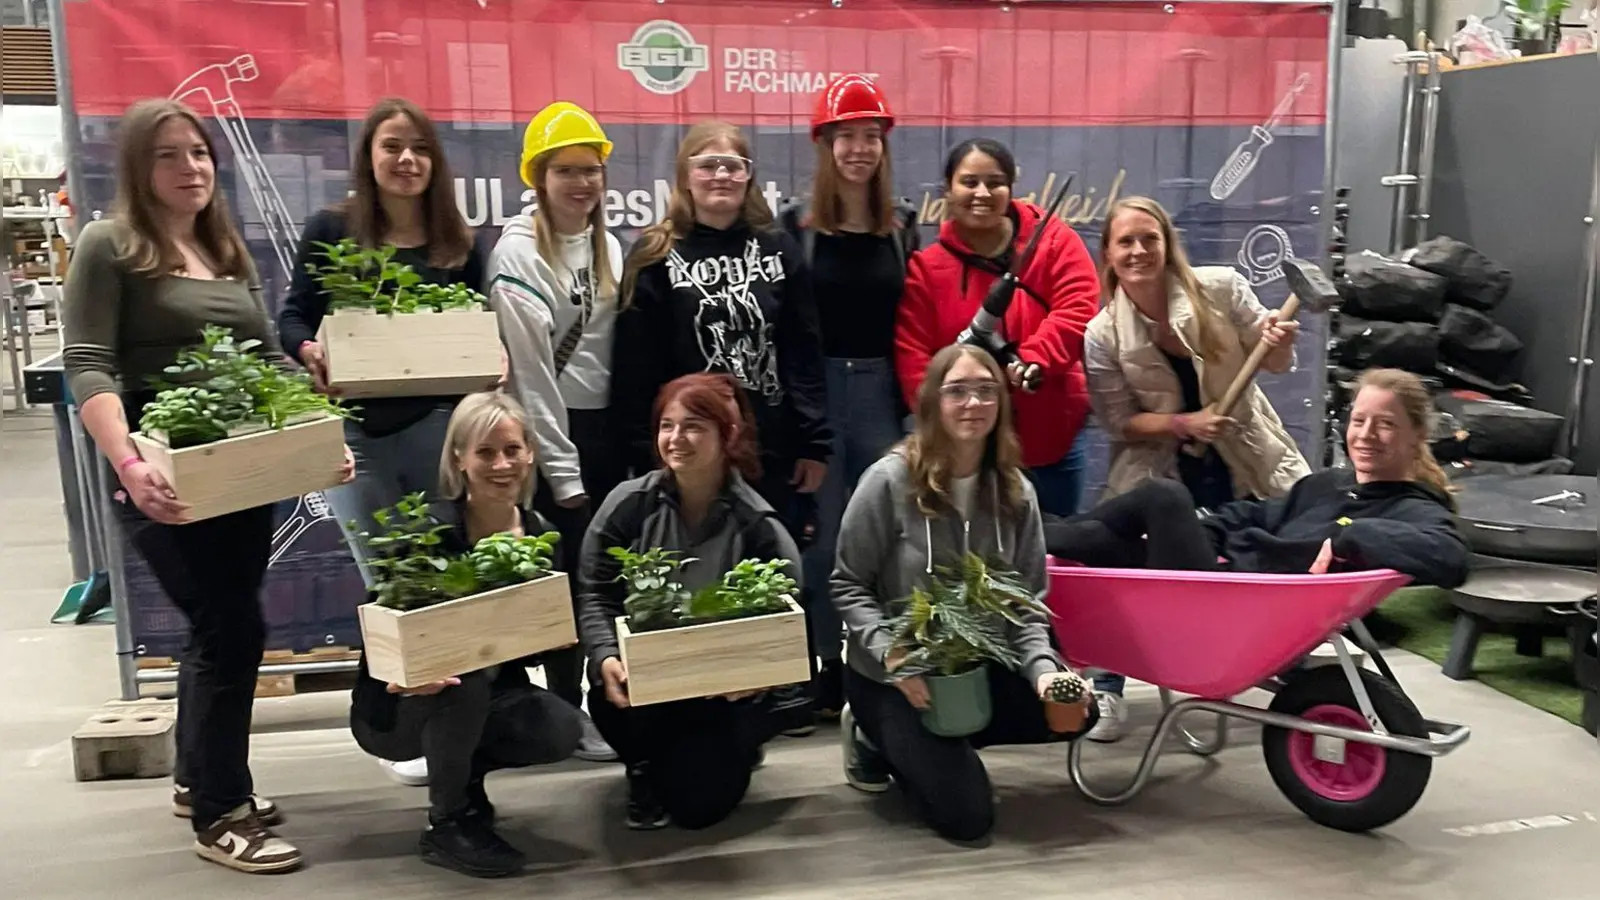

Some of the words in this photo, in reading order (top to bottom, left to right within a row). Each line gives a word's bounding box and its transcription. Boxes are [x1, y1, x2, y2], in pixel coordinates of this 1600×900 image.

[622, 46, 705, 68] BGU
[724, 47, 777, 70] DER
[724, 71, 880, 94] FACHMA
